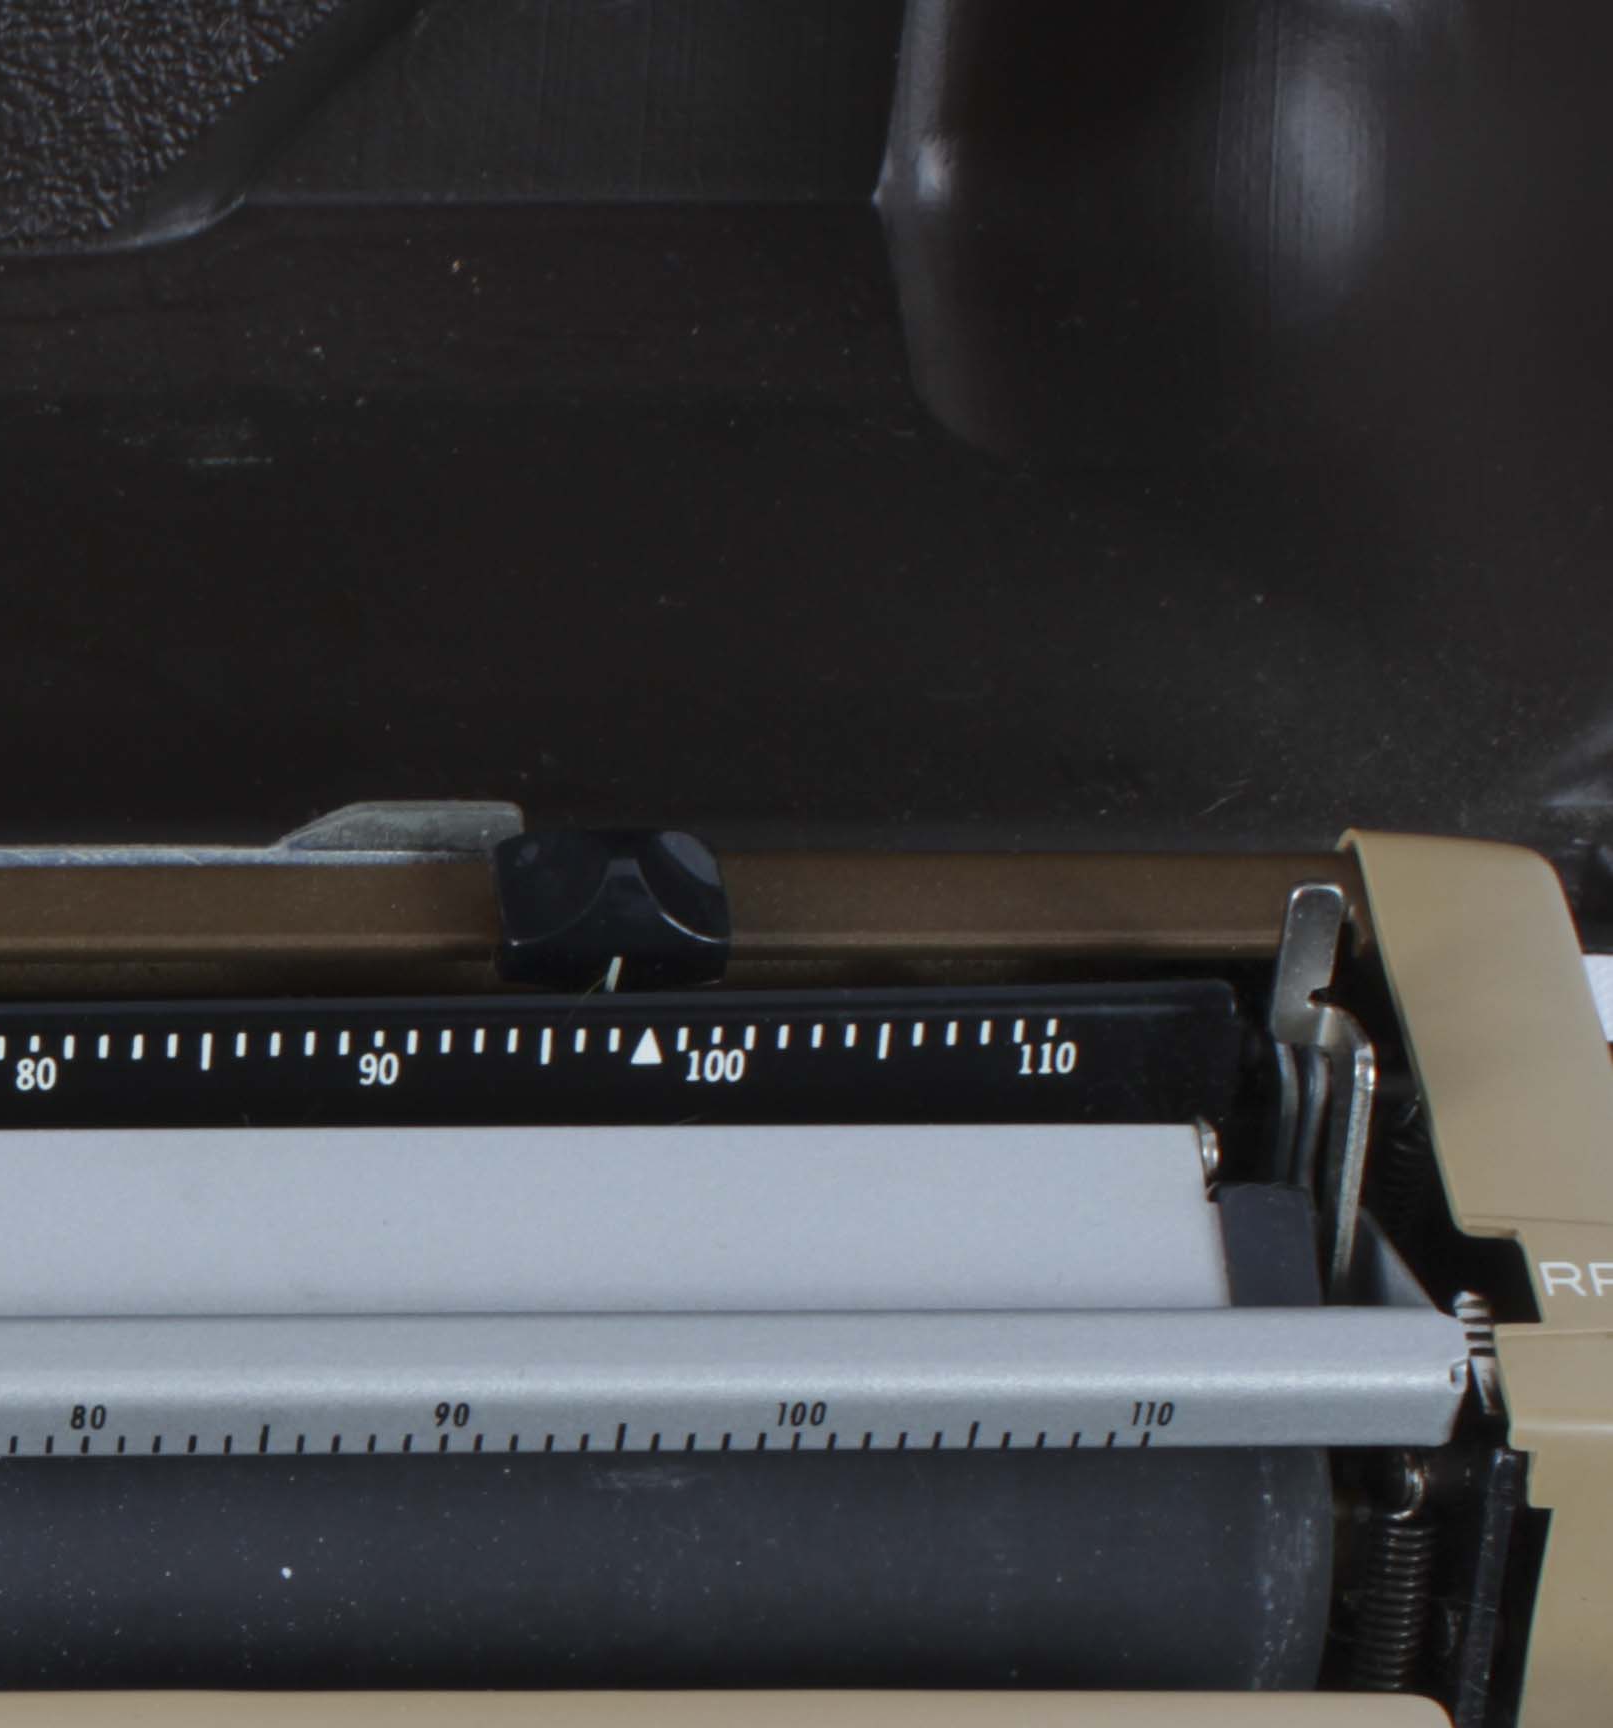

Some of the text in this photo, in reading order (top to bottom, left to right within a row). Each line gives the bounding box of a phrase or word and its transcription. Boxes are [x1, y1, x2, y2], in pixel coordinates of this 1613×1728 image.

[15, 1057, 57, 1091] 80
[359, 1052, 400, 1086] 90
[686, 1048, 745, 1083] 100
[1019, 1041, 1077, 1075] 110
[69, 1404, 107, 1431] 80
[434, 1402, 471, 1429] 90
[777, 1401, 828, 1428] 100
[1131, 1401, 1176, 1427] 110
